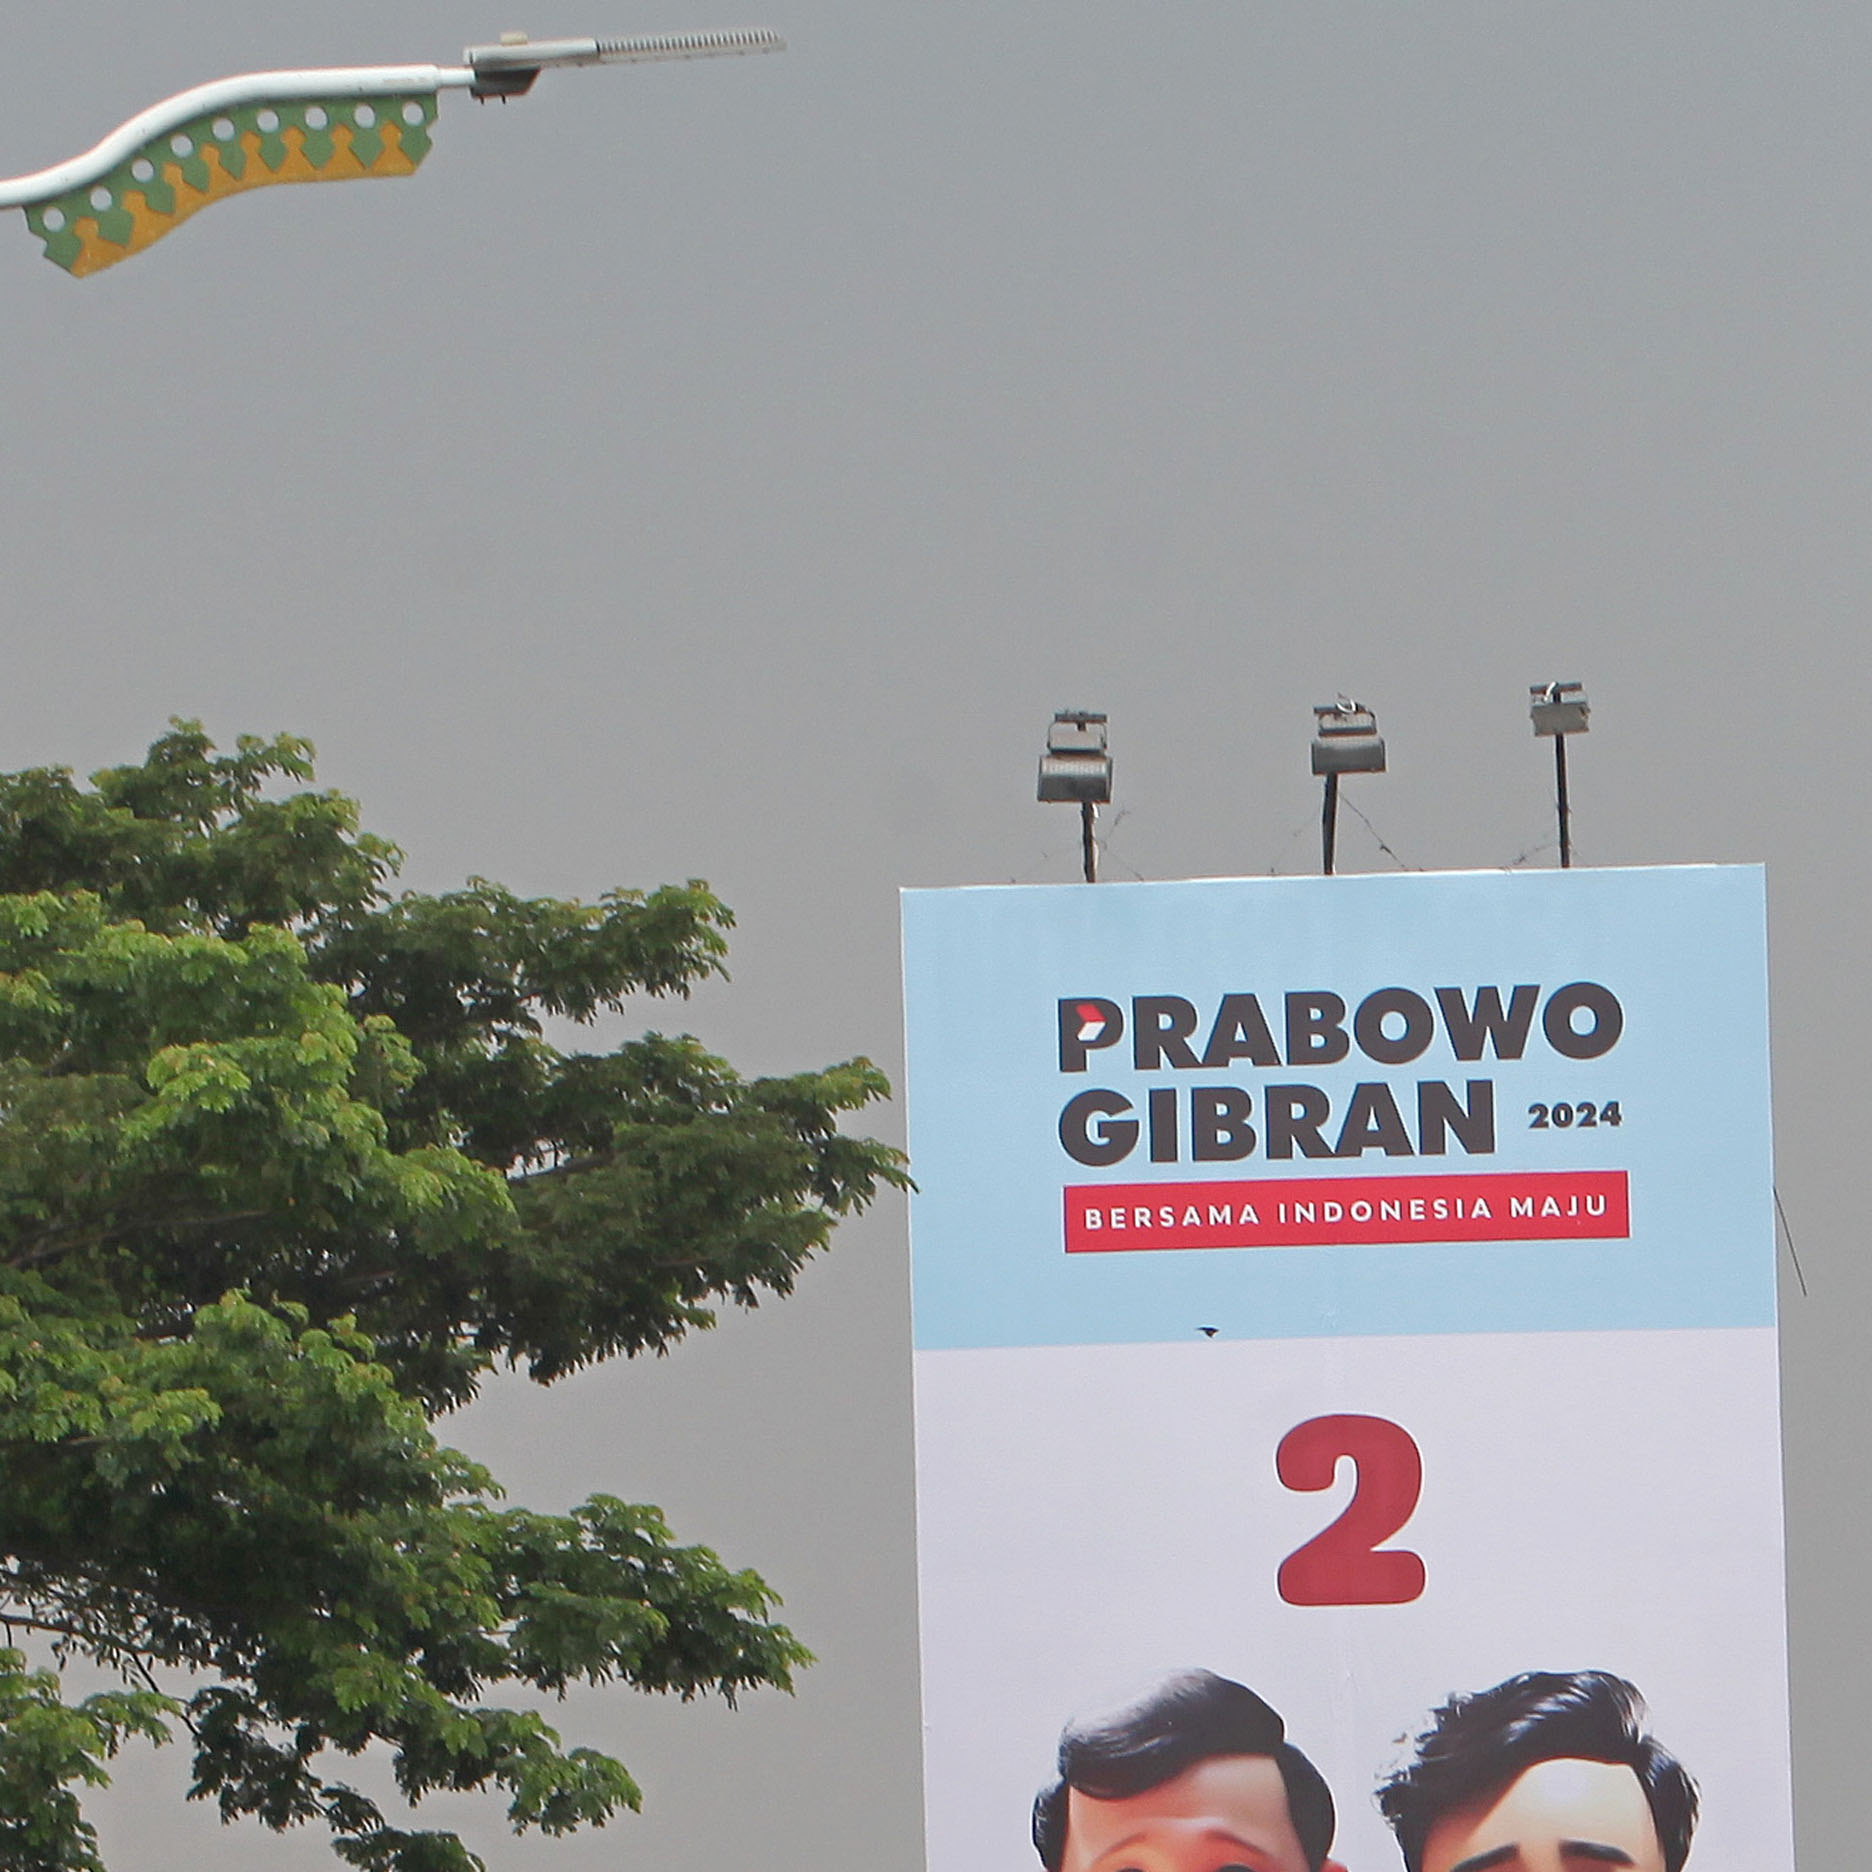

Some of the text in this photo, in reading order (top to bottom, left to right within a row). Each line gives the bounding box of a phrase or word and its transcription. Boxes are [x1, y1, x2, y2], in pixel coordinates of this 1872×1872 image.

[1057, 982, 1625, 1075] PRABOWO
[1058, 1080, 1624, 1168] GIBRAN 2024
[1084, 1193, 1608, 1232] BERSAMA INDONESIA MAJU
[1275, 1412, 1429, 1609] 2
